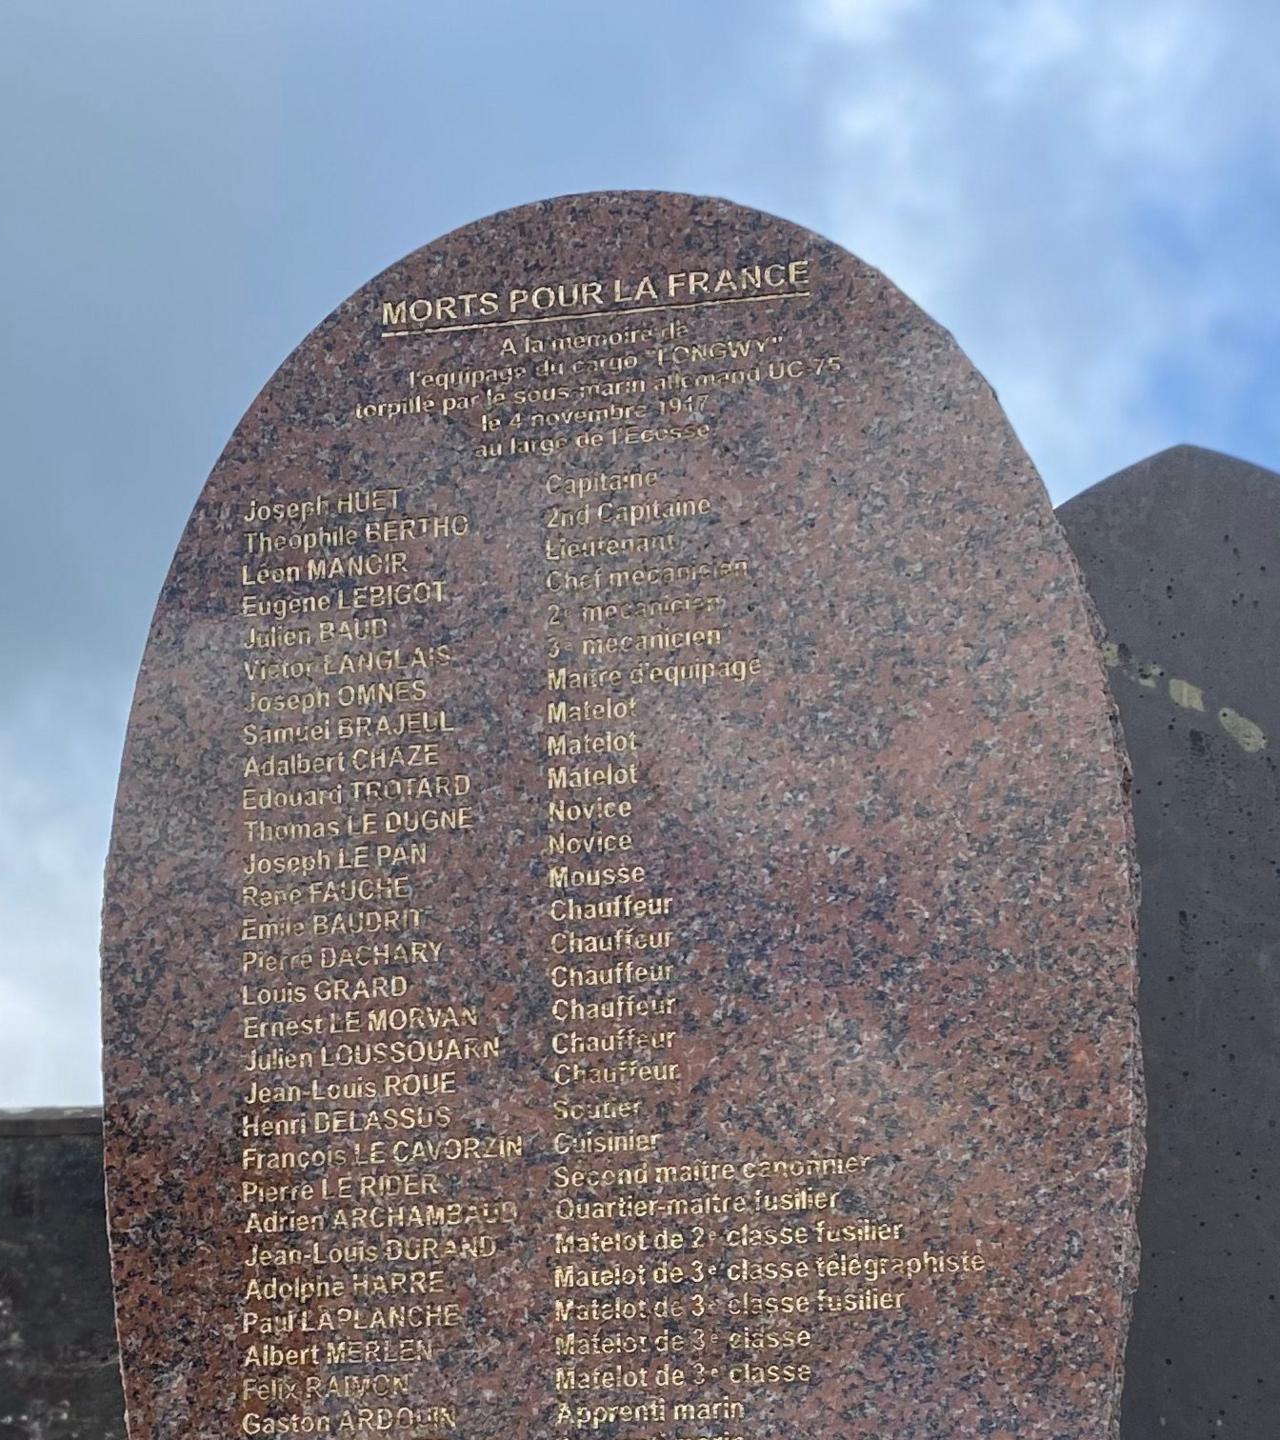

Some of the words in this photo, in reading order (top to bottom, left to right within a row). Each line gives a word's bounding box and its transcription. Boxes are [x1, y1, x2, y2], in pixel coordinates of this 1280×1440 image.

[381, 291, 499, 326] MORTS
[509, 281, 604, 314] POUR
[613, 275, 659, 304] LA
[667, 259, 810, 298] FRANCE
[572, 356, 638, 375] cargo
[442, 394, 479, 416] par
[486, 388, 506, 407] le
[653, 366, 761, 393] allemand
[768, 355, 842, 381] UC-75
[481, 414, 501, 433] le
[508, 414, 521, 430] 4
[530, 401, 647, 428] novembre
[474, 442, 503, 459] au
[510, 436, 568, 456] large
[575, 430, 604, 449] de
[544, 468, 658, 499] Capitaine
[337, 487, 403, 515] HUET
[546, 503, 591, 529] 2nd
[596, 497, 711, 527] Capitaine
[545, 532, 676, 561] Lieutenant
[545, 565, 604, 593] Chef
[337, 580, 447, 611] LEBIGOT
[244, 624, 311, 650] Julien
[319, 617, 388, 644] BAUD
[244, 657, 314, 682] Victor
[323, 643, 452, 676] LANGLAIS
[244, 686, 330, 716] Joseph
[337, 679, 427, 708] OMNES
[547, 697, 637, 724] Matelot
[337, 710, 455, 740] BRAJEUL
[547, 730, 637, 757] Matelot
[243, 751, 345, 779] Adalbert
[351, 743, 440, 772] CHAZE
[243, 817, 340, 843] Thomas
[347, 812, 377, 836] LE
[384, 806, 474, 834] DUGNE
[548, 797, 633, 823] Novice
[548, 830, 633, 855] Novice
[243, 848, 331, 877] Joseph
[337, 845, 369, 870] LE
[376, 842, 427, 867] PAN
[548, 864, 646, 889] Mousse
[550, 894, 673, 922] Chauffeur
[550, 927, 673, 955] Chauffeur
[242, 948, 313, 974] Pierre
[320, 940, 443, 970] DACHARY
[241, 981, 307, 1006] Louis
[313, 975, 408, 1002] GRARD
[243, 1014, 323, 1040] Ernest
[367, 1004, 479, 1032] MORVAN
[244, 1047, 313, 1073] Julien
[244, 1077, 377, 1106] Jean-Louis
[241, 1110, 307, 1139] Henri
[313, 1105, 452, 1134] DELASSUS
[241, 1146, 347, 1172] François
[392, 1135, 523, 1164] CAVORZIN
[553, 1129, 662, 1156] Cuisinier
[553, 1161, 648, 1189] Second
[742, 1154, 871, 1180] canonnier
[241, 1180, 314, 1204] Pierre
[320, 1175, 353, 1200] LE
[359, 1172, 440, 1199] RIDER
[754, 1186, 840, 1213] fusilier
[244, 1209, 325, 1234] Adrien
[331, 1200, 519, 1230] ARCHAMBAUD
[726, 1222, 809, 1248] classe
[815, 1218, 904, 1244] fusilier
[244, 1239, 379, 1268] Jean-Louis
[385, 1235, 497, 1262] DURAND
[726, 1258, 810, 1282] classe
[244, 1274, 346, 1304] Adolphe
[241, 1309, 296, 1336] Paul
[300, 1303, 461, 1331] LAPLANCHE
[243, 1343, 320, 1368] Albert
[325, 1339, 435, 1366] MERLEN
[241, 1411, 330, 1437] Gaston
[337, 1404, 457, 1432] ARDOUIN
[556, 1397, 666, 1427] Apprenti
[672, 1395, 746, 1422] marin
